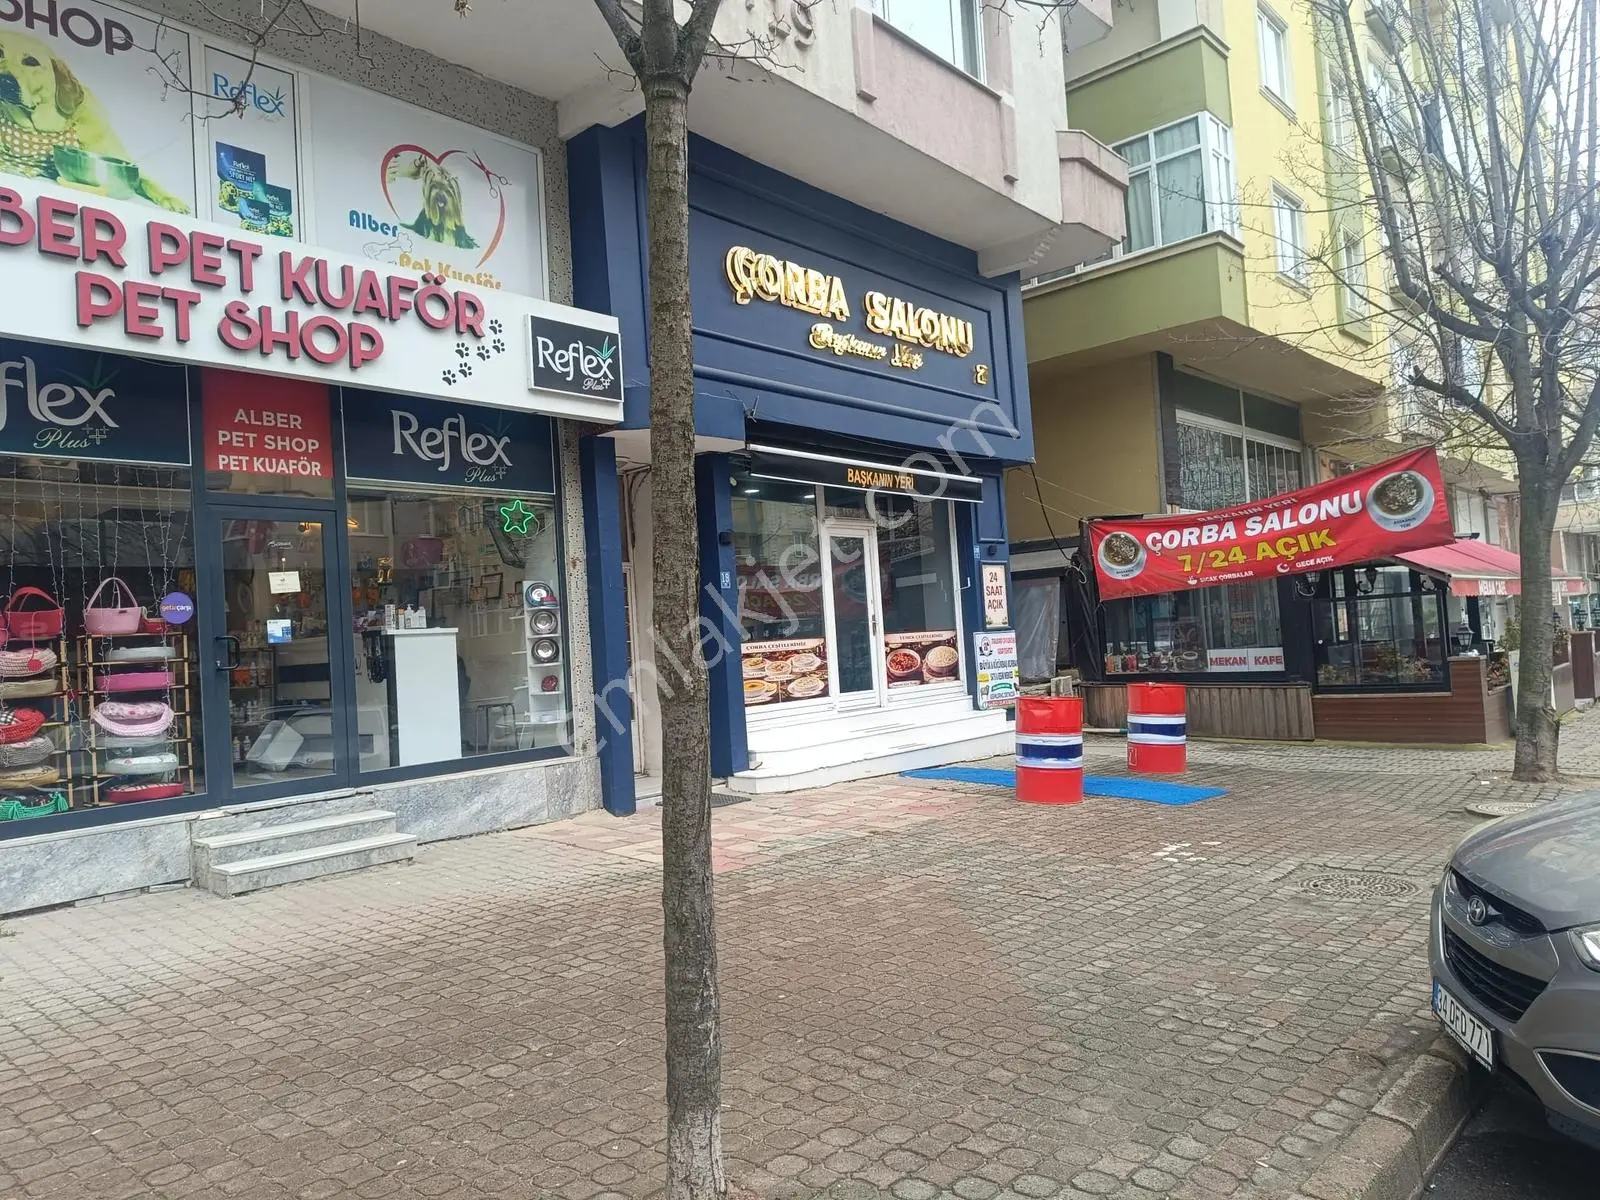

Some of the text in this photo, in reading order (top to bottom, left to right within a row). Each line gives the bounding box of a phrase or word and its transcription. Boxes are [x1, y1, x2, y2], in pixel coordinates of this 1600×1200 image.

[348, 209, 398, 238] Alber
[0, 186, 485, 338] BER PET KUAFÖR
[725, 245, 974, 358] ÇORBA SALONU
[75, 271, 384, 369] PET SHOP
[536, 336, 615, 381] Reflex
[234, 408, 303, 430] ALBER
[33, 427, 92, 449] Plus
[218, 430, 320, 453] PET SHOP
[390, 409, 513, 472] Reflex
[218, 454, 322, 476] PET KUAFÖR
[847, 467, 915, 490] BAŞKANIN YERİ
[1145, 489, 1363, 557] ÇORBA SALONU
[1177, 529, 1337, 575] 7/24 AÇIK
[988, 571, 998, 583] 24
[985, 585, 1003, 597] SAAT
[987, 599, 1004, 612] AÇIK
[1210, 655, 1284, 667] MEKAN KAFE
[1437, 988, 1448, 1017] 34
[1469, 1018, 1490, 1059] 771
